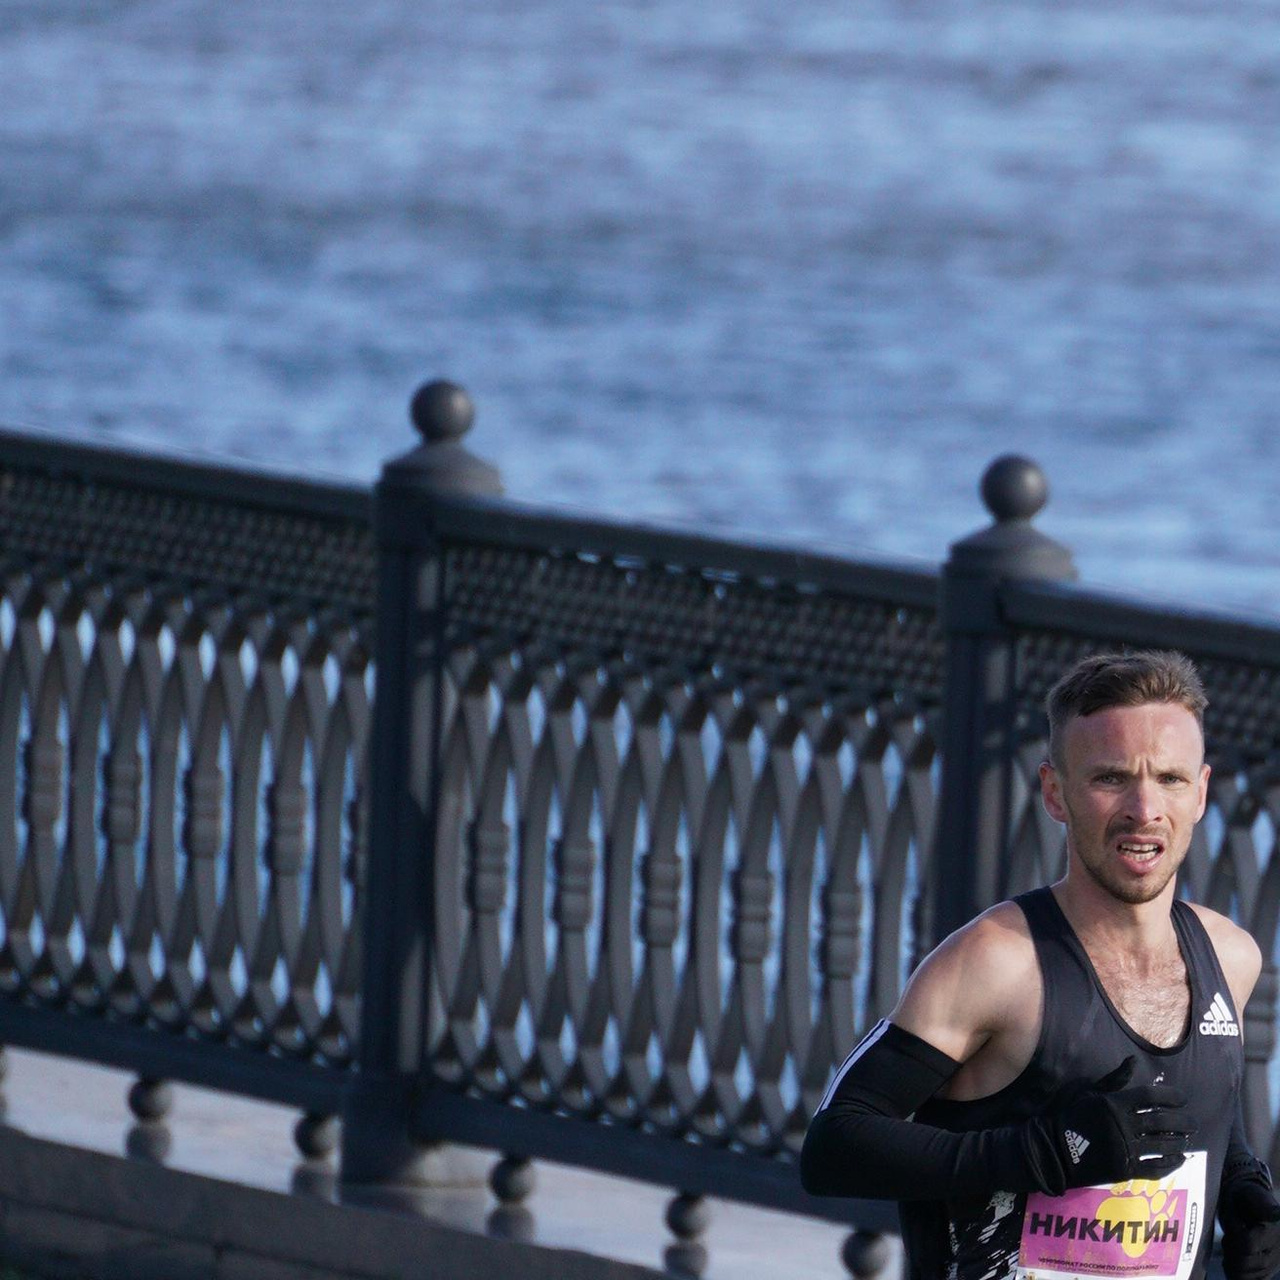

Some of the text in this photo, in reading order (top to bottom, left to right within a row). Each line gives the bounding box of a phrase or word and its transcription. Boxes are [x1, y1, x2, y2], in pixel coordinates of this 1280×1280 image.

[1199, 1021, 1239, 1036] adidas
[1064, 1130, 1080, 1164] adidas
[1029, 1212, 1180, 1244] НИКИТИН
